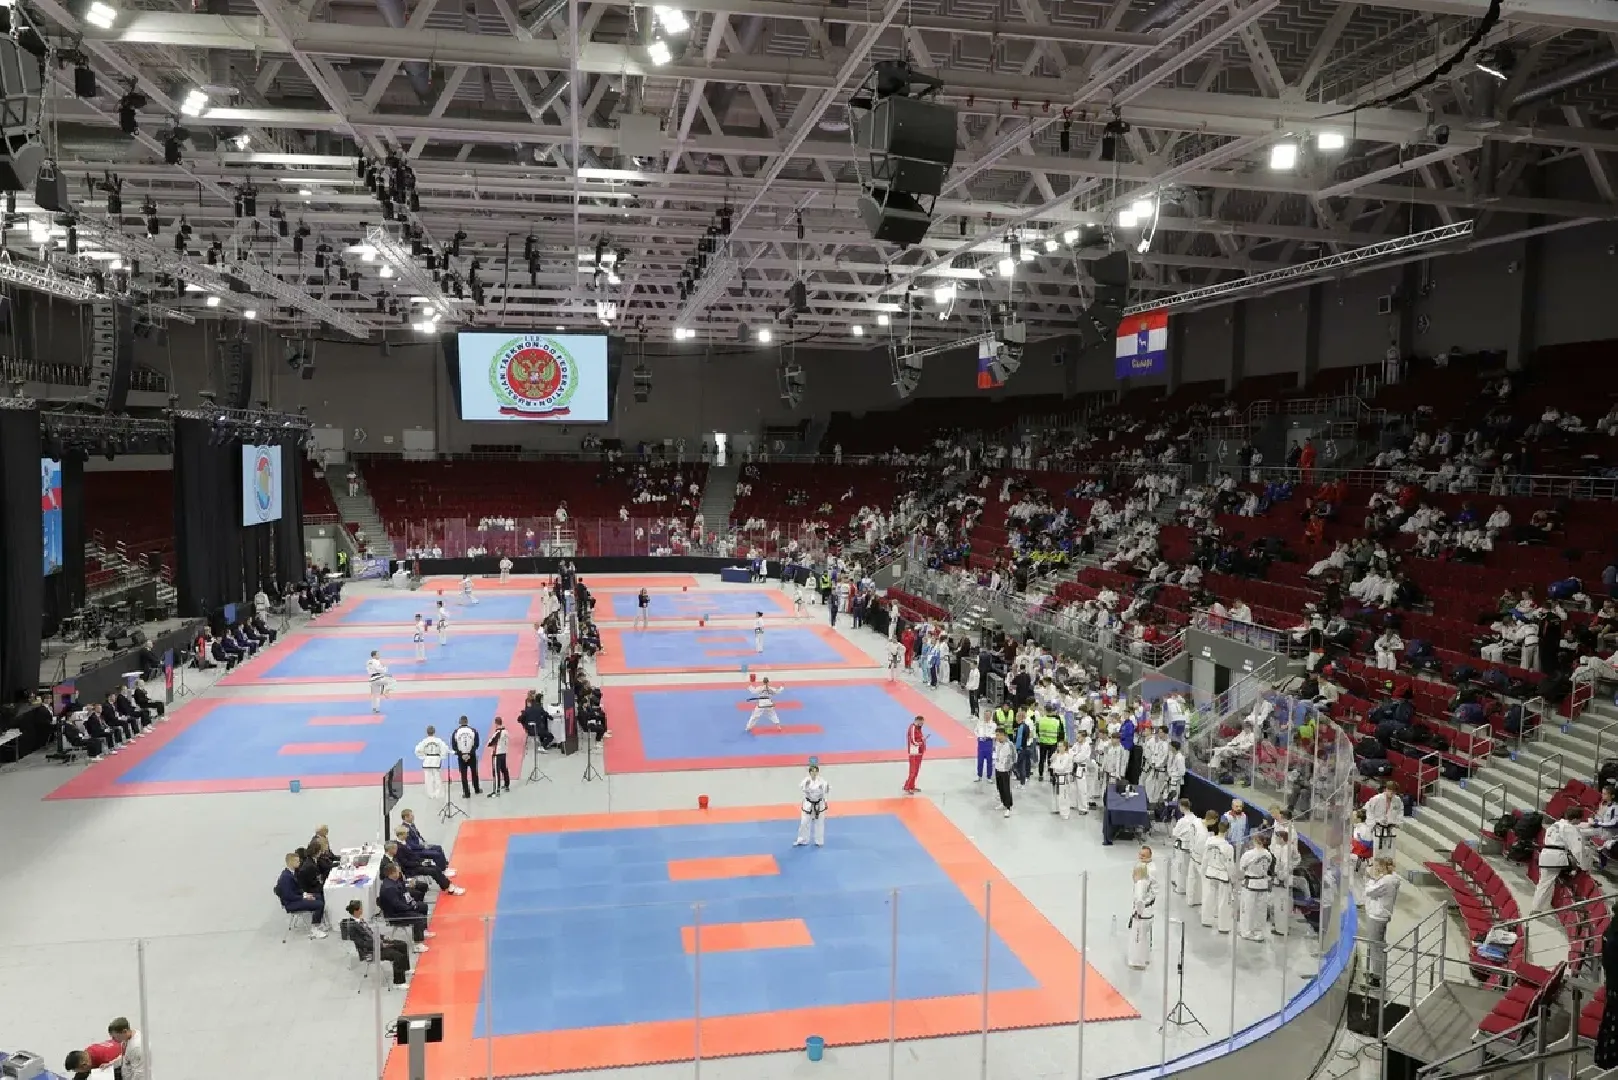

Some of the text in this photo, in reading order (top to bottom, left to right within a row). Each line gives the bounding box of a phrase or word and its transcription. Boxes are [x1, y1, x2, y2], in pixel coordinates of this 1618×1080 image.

[500, 341, 567, 406] RUSSIAN TAEKWON-DO FEDERATION
